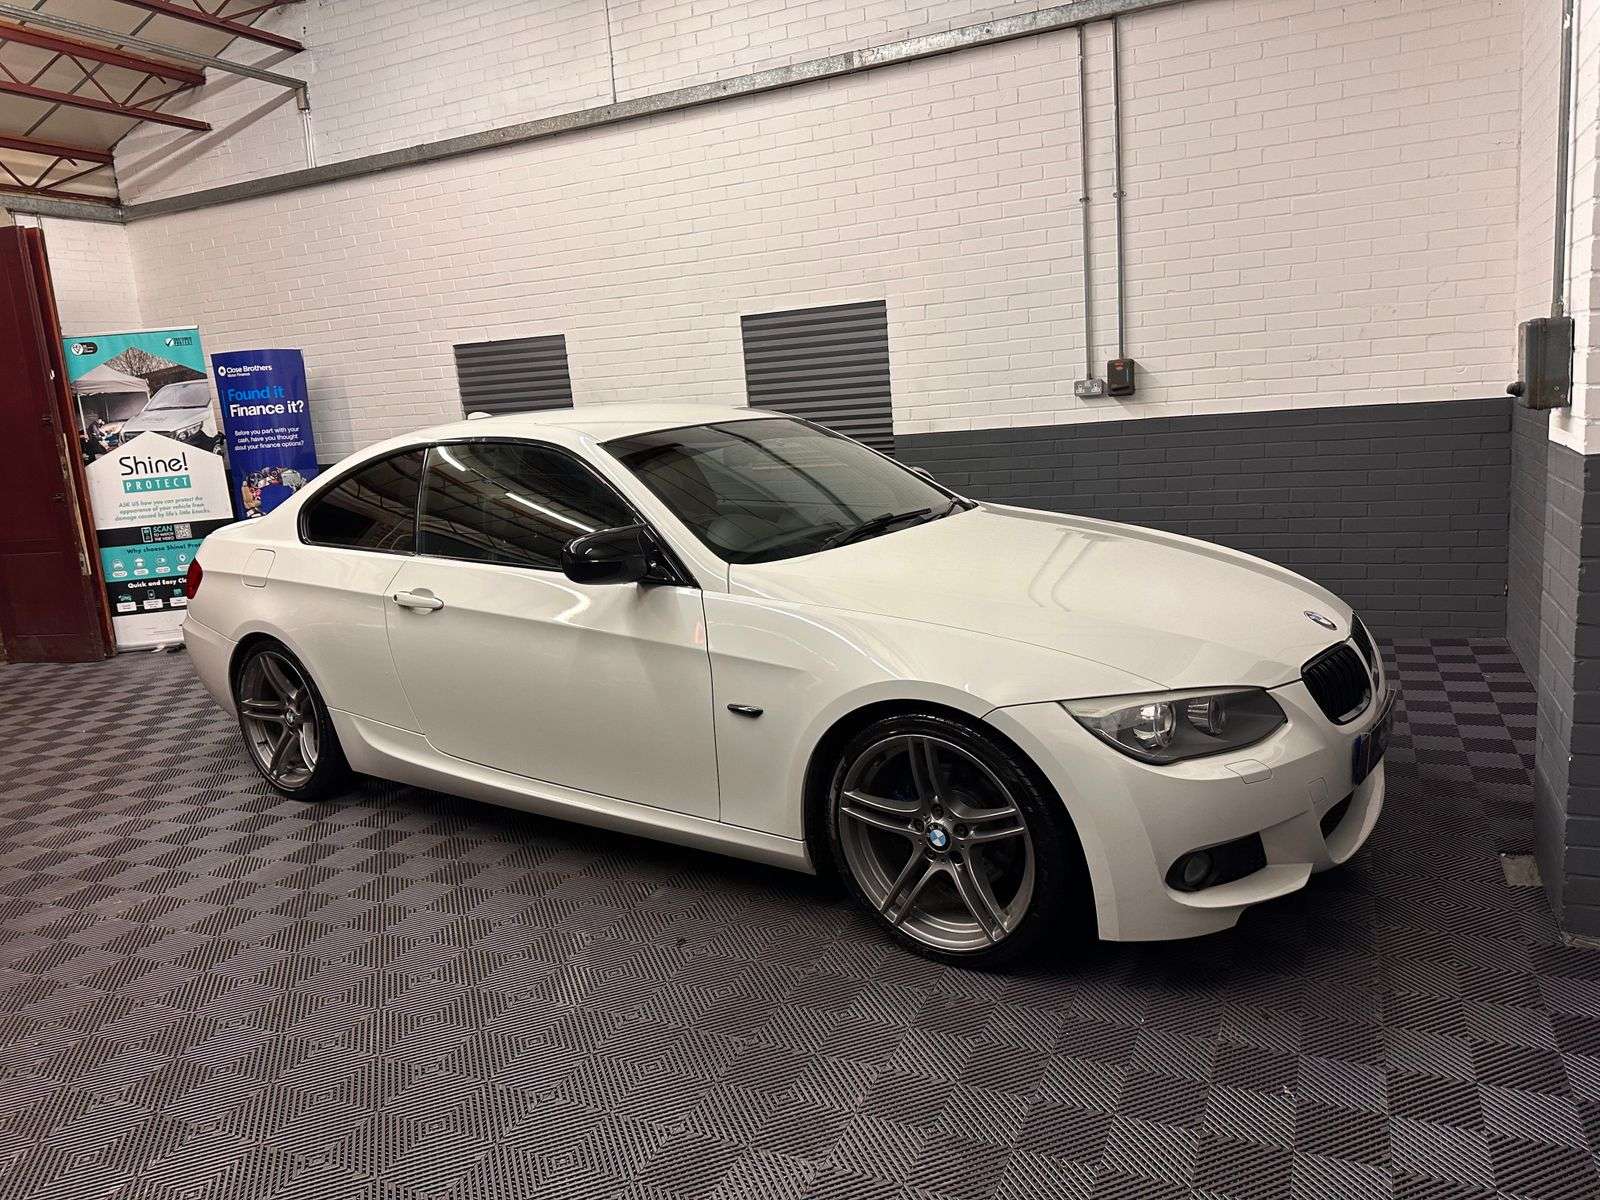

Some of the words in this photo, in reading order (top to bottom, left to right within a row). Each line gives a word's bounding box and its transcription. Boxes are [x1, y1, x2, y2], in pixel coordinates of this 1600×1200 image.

[228, 386, 270, 401] Found
[273, 386, 284, 398] it
[229, 403, 285, 418] Finance
[287, 400, 304, 414] it?
[264, 435, 276, 443] you
[281, 440, 305, 448] options?
[118, 451, 189, 476] Shine!
[126, 477, 188, 491] PROTECT
[153, 525, 173, 533] SCAN
[128, 580, 147, 589] Quick
